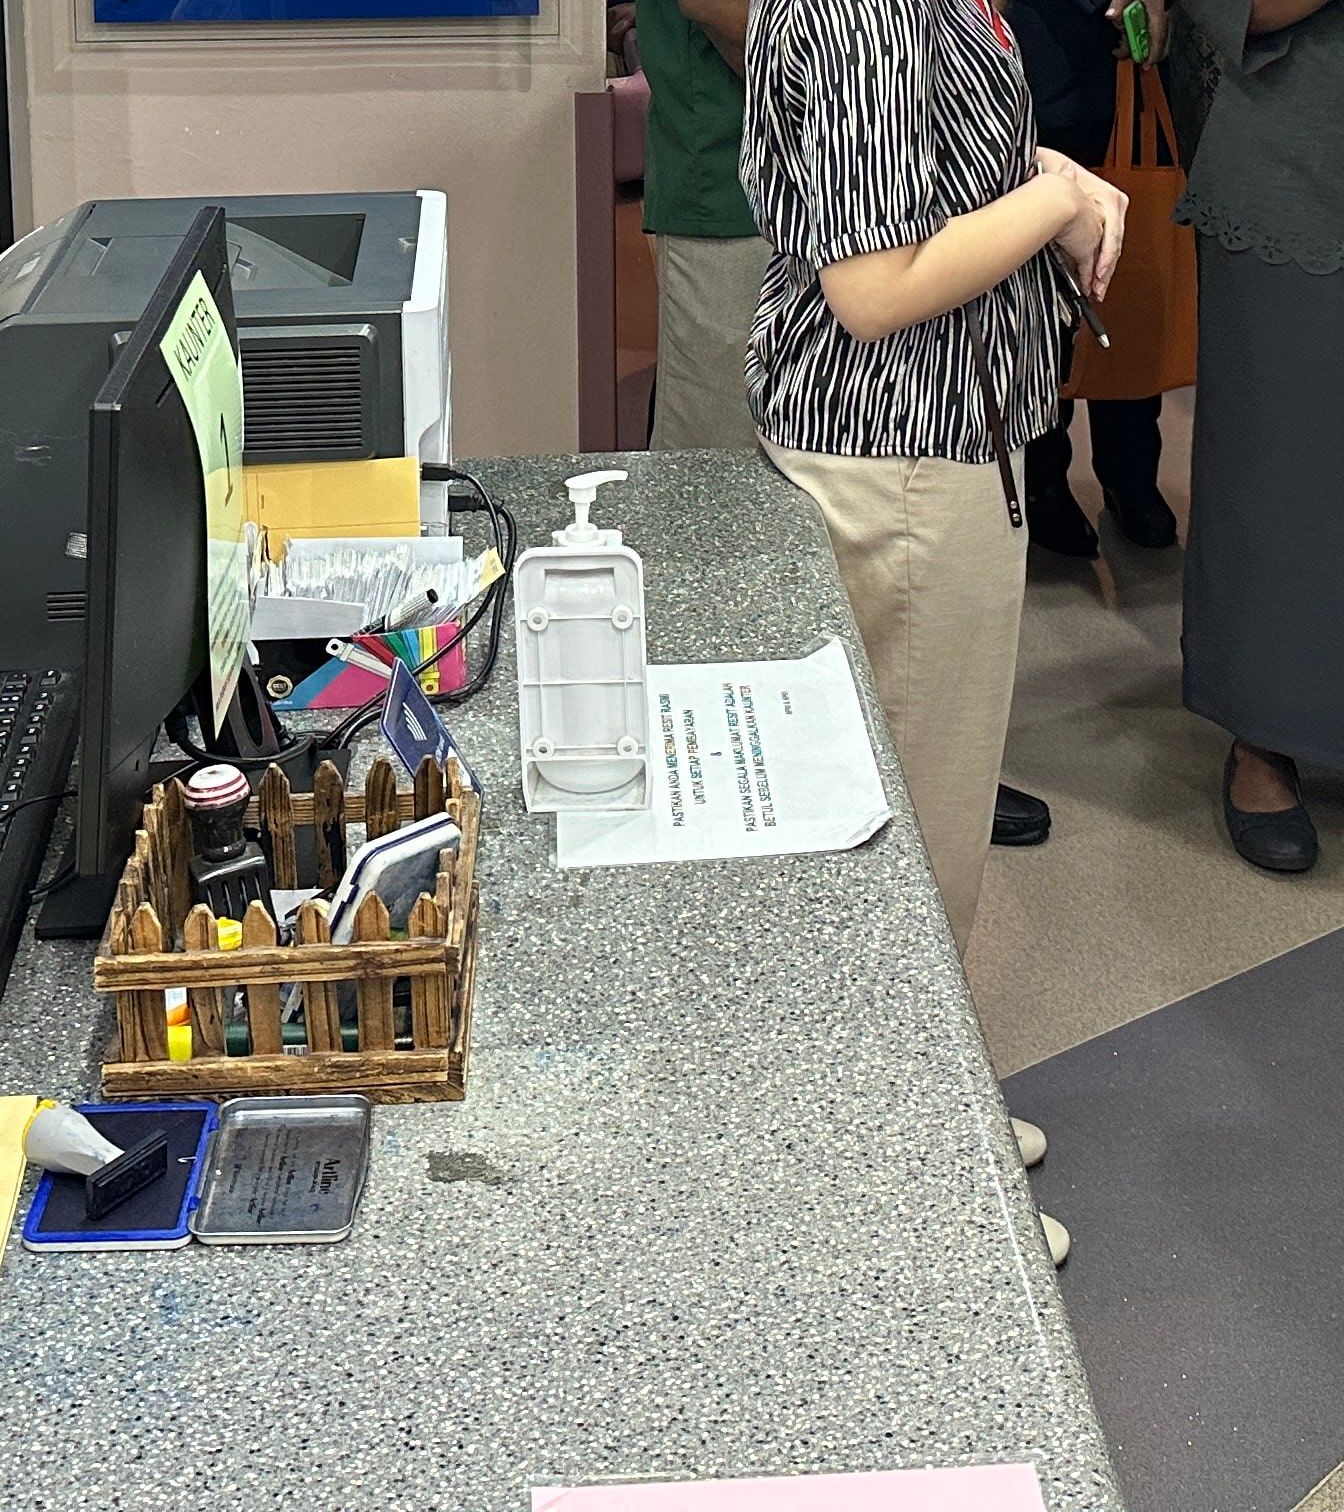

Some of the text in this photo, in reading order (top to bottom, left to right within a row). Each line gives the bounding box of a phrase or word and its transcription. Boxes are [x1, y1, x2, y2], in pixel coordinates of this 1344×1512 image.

[173, 297, 216, 382] KAUNTER
[660, 694, 684, 826] PASTIKAN ANDA MENERIMA RESIT RASMI
[683, 710, 706, 804] UNTUK SETIAP PEMBAYARAN
[723, 683, 756, 831] PASTIKAN SEGALA MAKLUMAT RESIT ADALAH
[755, 769, 771, 801] SEBELUM
[762, 803, 776, 826] BETUL
[319, 1157, 342, 1195] Artline
